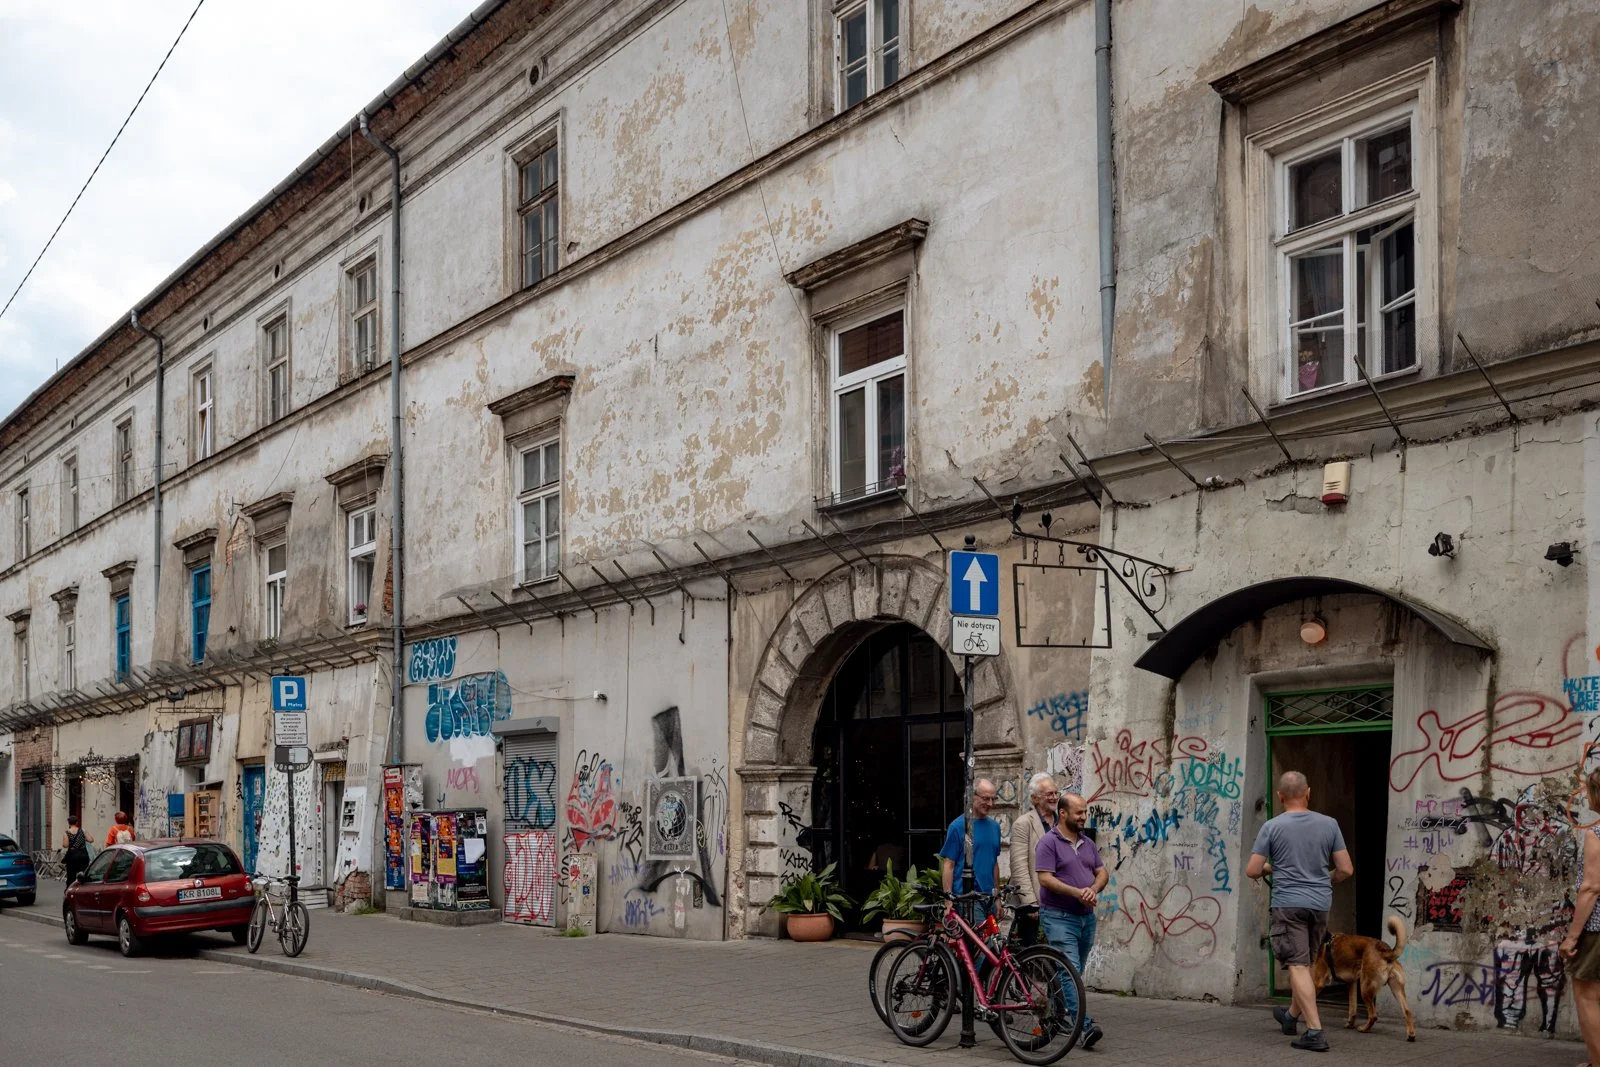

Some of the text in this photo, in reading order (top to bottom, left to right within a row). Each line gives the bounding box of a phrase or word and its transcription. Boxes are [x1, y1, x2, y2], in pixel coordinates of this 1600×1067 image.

[957, 620, 996, 632] Nie dotyczy
[280, 680, 299, 707] P
[1420, 817, 1470, 830] GAZA
[183, 890, 195, 899] KR
